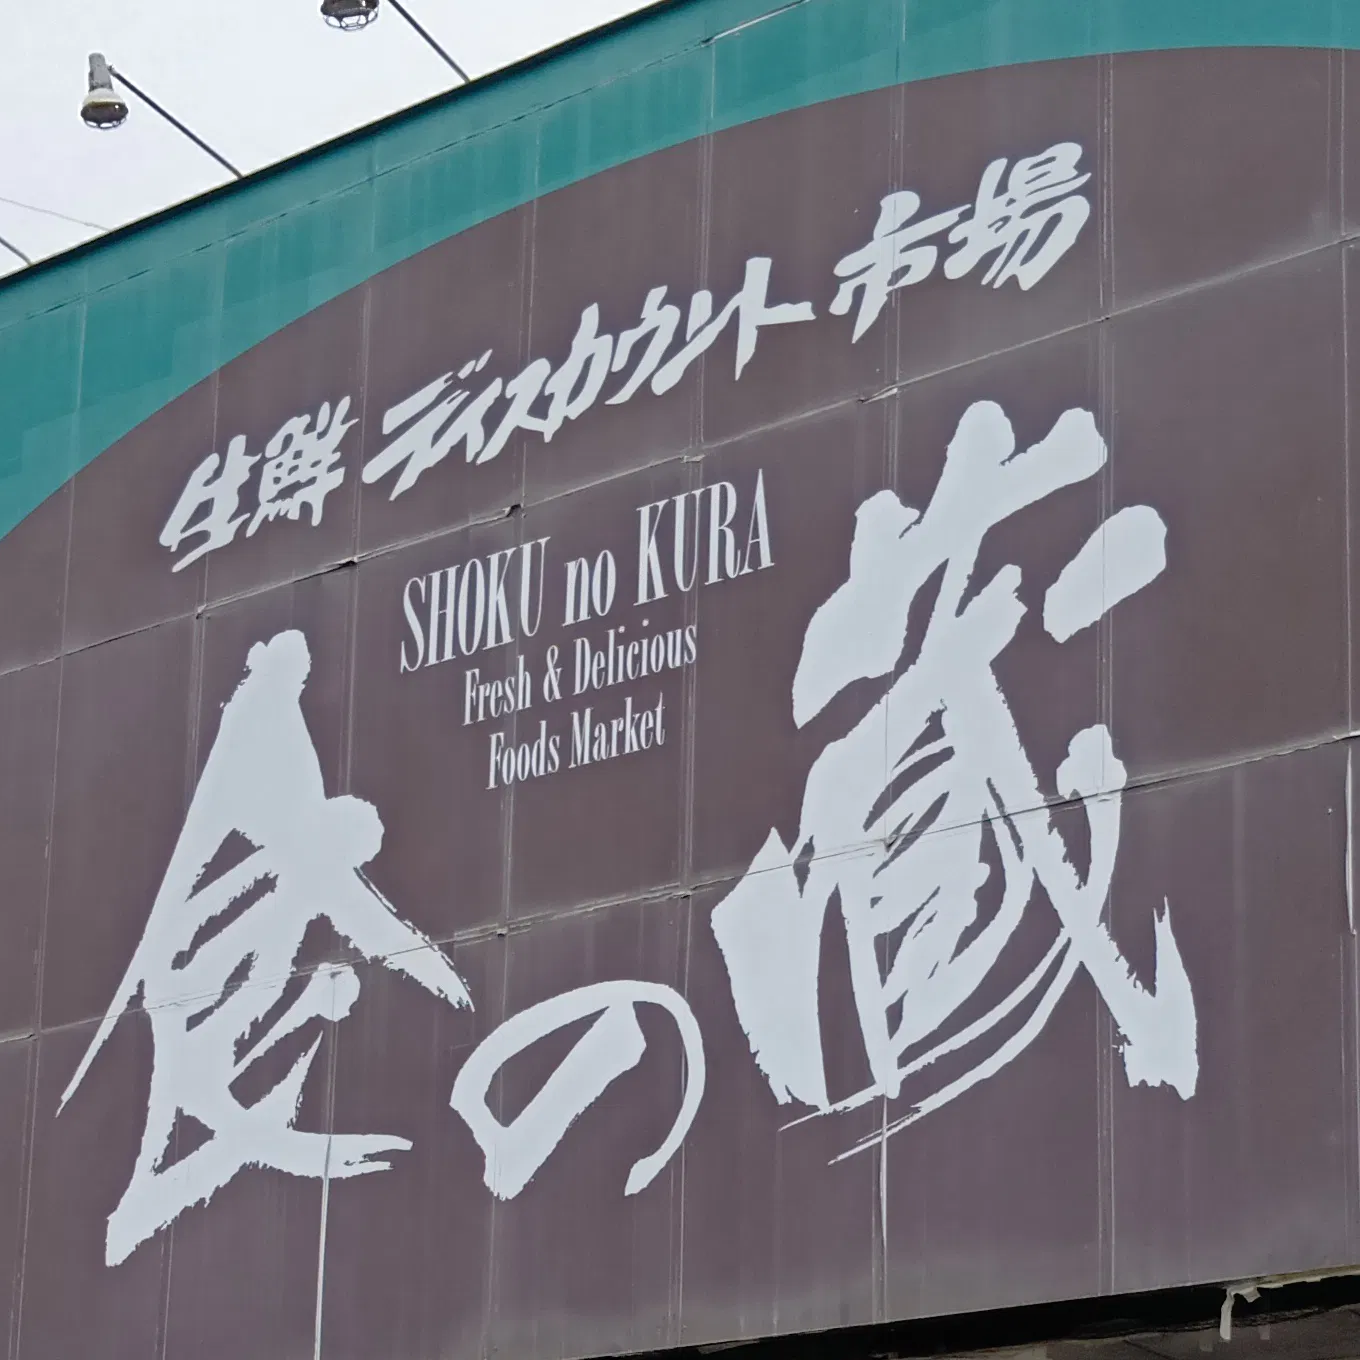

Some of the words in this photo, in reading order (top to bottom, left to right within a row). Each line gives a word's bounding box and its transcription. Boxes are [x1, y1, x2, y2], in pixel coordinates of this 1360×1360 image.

[160, 396, 358, 572] 生鮮
[362, 258, 816, 500] ディスカウント
[830, 143, 1091, 343] 市場
[400, 537, 551, 673] SHOKU
[562, 549, 616, 627] no
[633, 468, 775, 606] KURA
[462, 655, 532, 726] Fresh
[543, 645, 563, 702] &
[572, 618, 697, 696] Delicious
[57, 398, 1199, 1267] 食の蔵
[486, 720, 561, 790] Foods
[568, 691, 667, 769] Market
